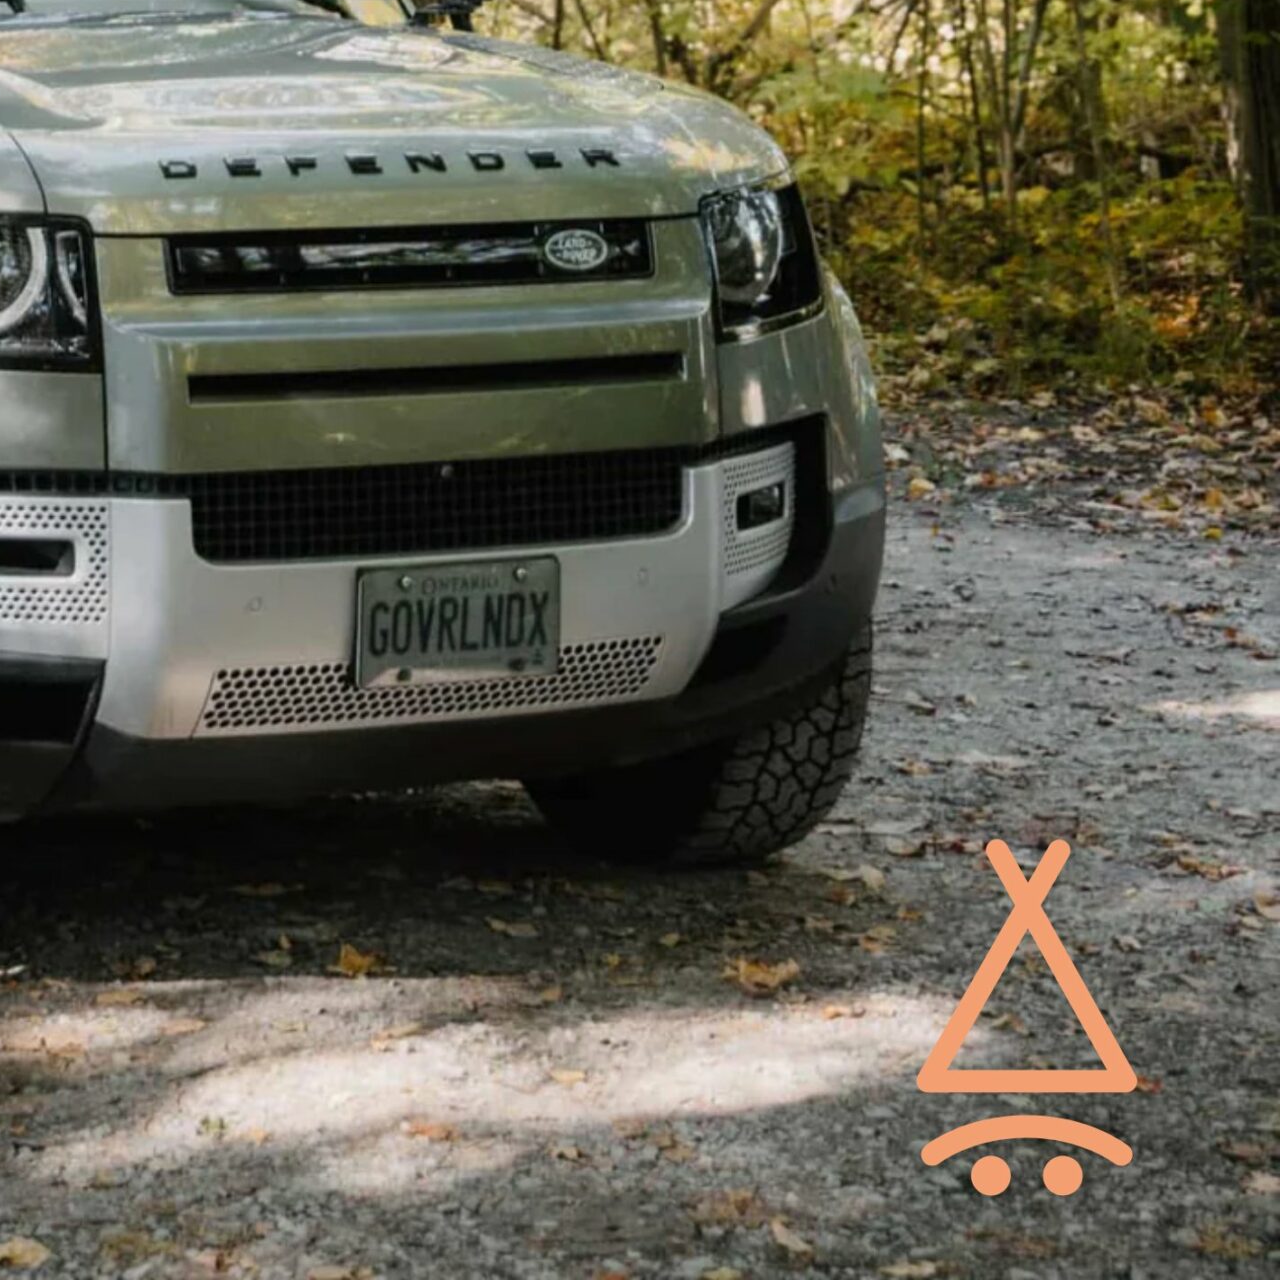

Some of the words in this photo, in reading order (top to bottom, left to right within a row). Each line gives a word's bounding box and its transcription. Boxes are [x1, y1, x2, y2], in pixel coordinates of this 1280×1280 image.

[159, 148, 620, 179] DEFENDER
[556, 237, 586, 249] LAND
[370, 590, 549, 656] GOVRLNDX
